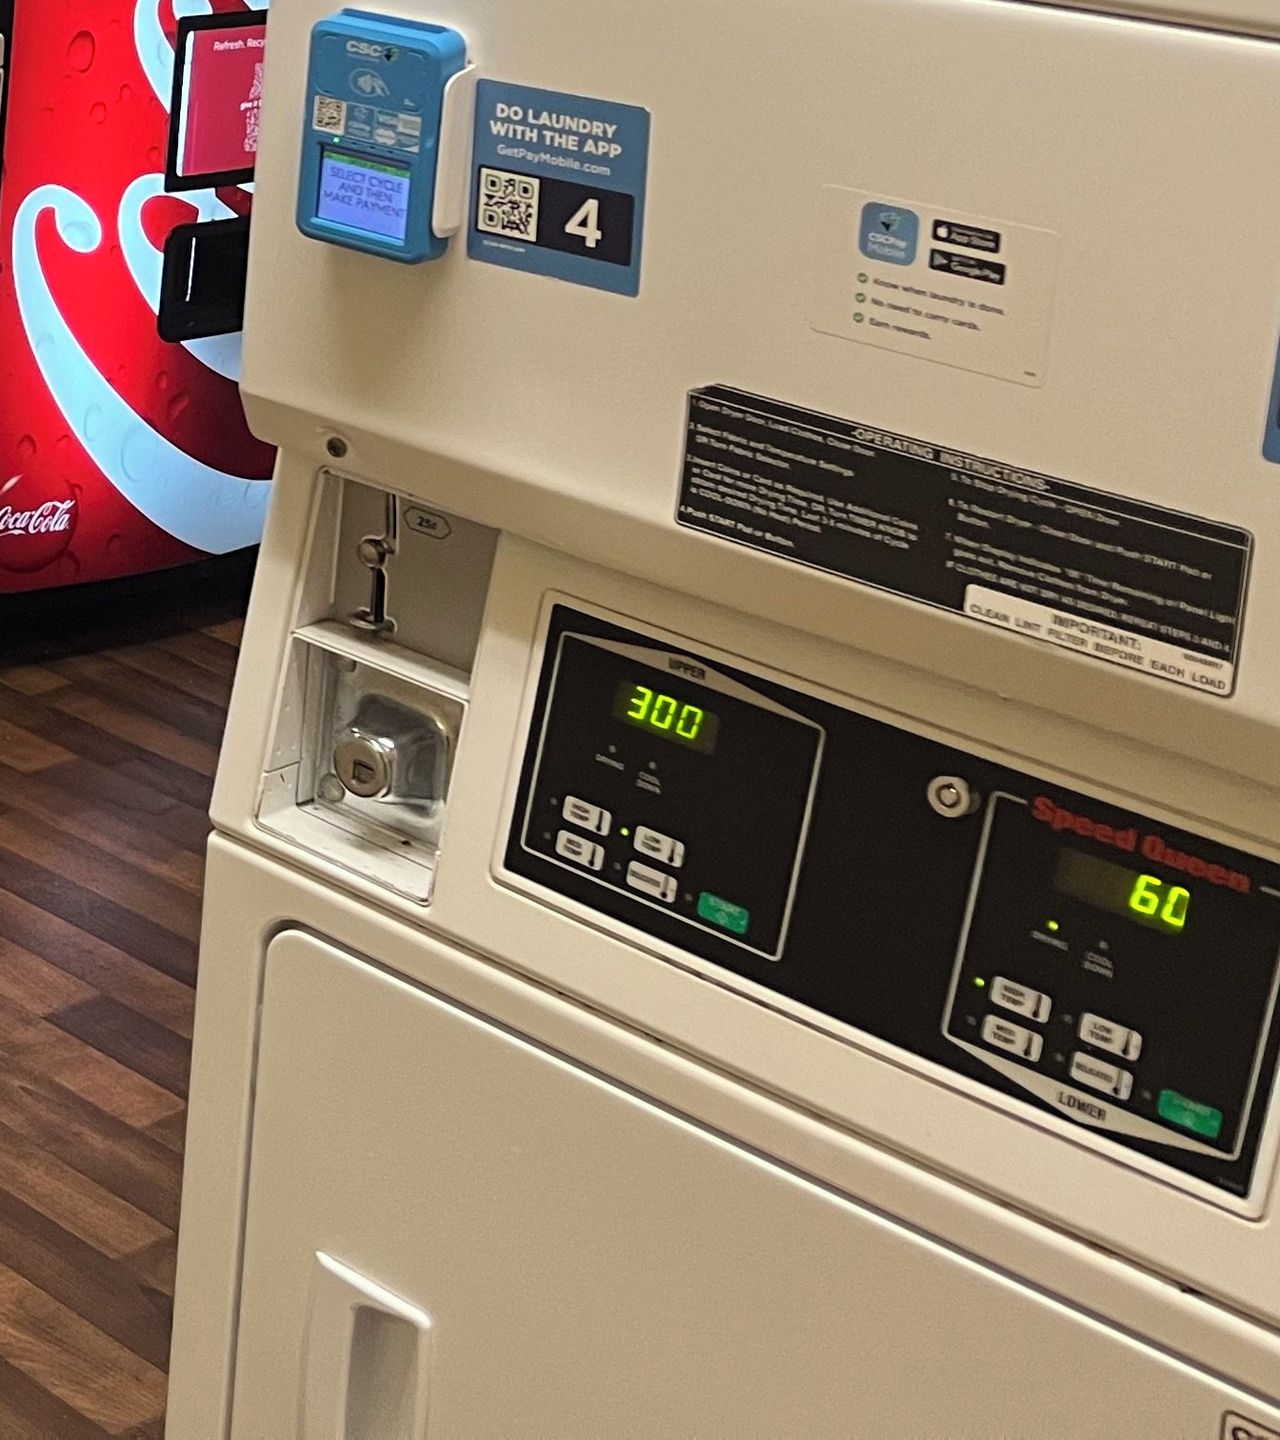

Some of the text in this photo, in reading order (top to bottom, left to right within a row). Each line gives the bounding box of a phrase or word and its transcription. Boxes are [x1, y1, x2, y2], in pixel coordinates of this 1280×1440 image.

[346, 41, 381, 58] CSC
[496, 102, 618, 139] DO LAUNDRY
[490, 118, 623, 160] WITH THE APP
[496, 143, 611, 177] GetPayMobile.com
[329, 165, 403, 194] SELECT CYCLE
[337, 181, 364, 196] AND
[323, 189, 353, 206] MAKE
[563, 198, 603, 249] 4
[968, 603, 1011, 626] CLEAN
[1015, 615, 1043, 635] LINT
[1047, 627, 1089, 649] FILTER
[1093, 642, 1145, 666] BEFORE
[1150, 658, 1186, 680] EACH
[1190, 670, 1227, 692] LOAD
[1051, 613, 1142, 651] IMPORTANT:
[668, 655, 706, 682] UPPER
[626, 685, 704, 740] 300
[1032, 796, 1252, 893] Speed Queen
[1128, 874, 1192, 928] 60
[1093, 1022, 1114, 1035] LOW
[1057, 1090, 1108, 1122] LOWER
